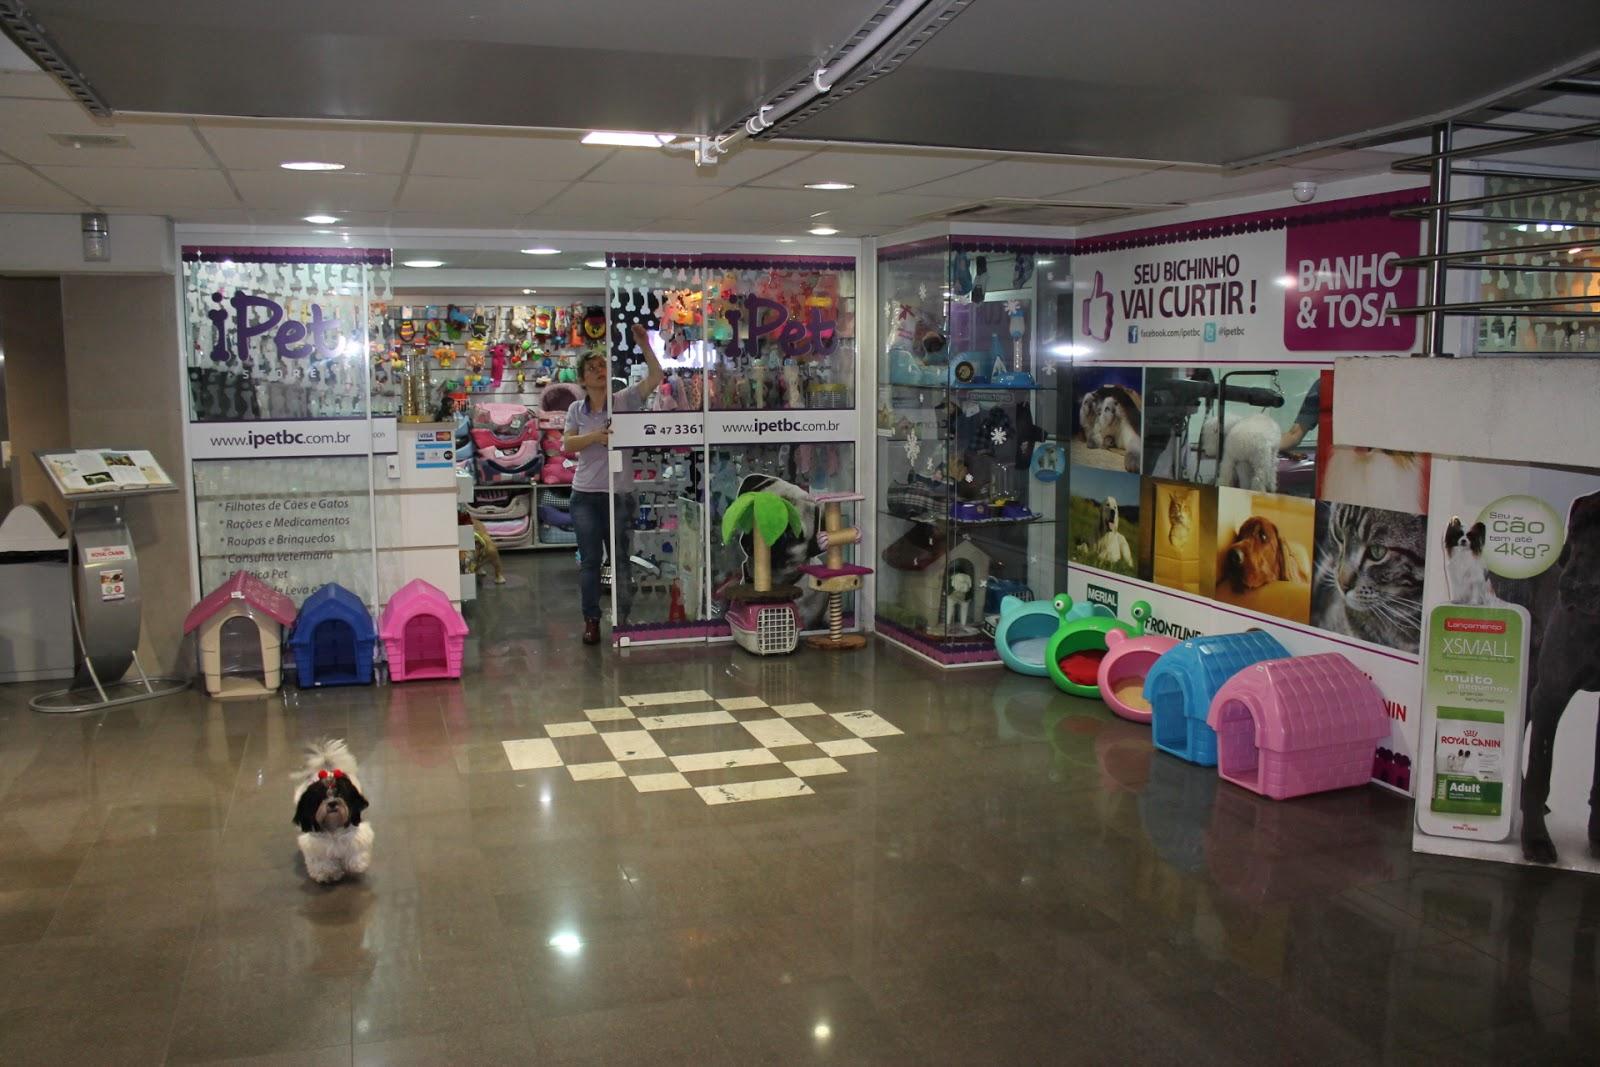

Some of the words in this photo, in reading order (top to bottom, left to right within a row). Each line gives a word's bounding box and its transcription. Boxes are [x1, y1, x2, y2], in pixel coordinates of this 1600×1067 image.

[1134, 263, 1160, 286] SEU
[1163, 254, 1240, 282] BICHINHO
[1298, 251, 1403, 292] BANHO
[1120, 288, 1154, 320] VAI
[1296, 296, 1317, 329] &
[1323, 291, 1401, 328] TOSA
[208, 290, 346, 362] iPet
[724, 293, 838, 357] iPet
[242, 369, 317, 379] SORE
[675, 424, 704, 434] 3361
[722, 418, 840, 435] www.ipetbc.com.br
[210, 430, 350, 449] www.ipetbc.com.br
[225, 501, 266, 512] Filhotes
[268, 500, 281, 510] de
[283, 498, 308, 510] Cães
[318, 498, 349, 510] Gatos
[226, 518, 263, 530] Rações
[265, 520, 272, 528] e
[273, 516, 350, 528] Medicamentos
[1493, 516, 1545, 534] cão
[227, 535, 266, 547] Roupas
[276, 532, 335, 545] Brinquedos
[1514, 535, 1533, 543] até
[228, 551, 275, 563] Consulta
[1494, 543, 1550, 559] 4kg?
[271, 569, 288, 579] Pet
[1088, 587, 1118, 606] MERIAL
[1443, 638, 1514, 658] XSMALL
[1445, 674, 1493, 685] muito
[1382, 698, 1407, 722] NIN
[1441, 736, 1470, 746] ROYAL
[1471, 738, 1501, 748] CANIN
[1449, 782, 1481, 793] Adult
